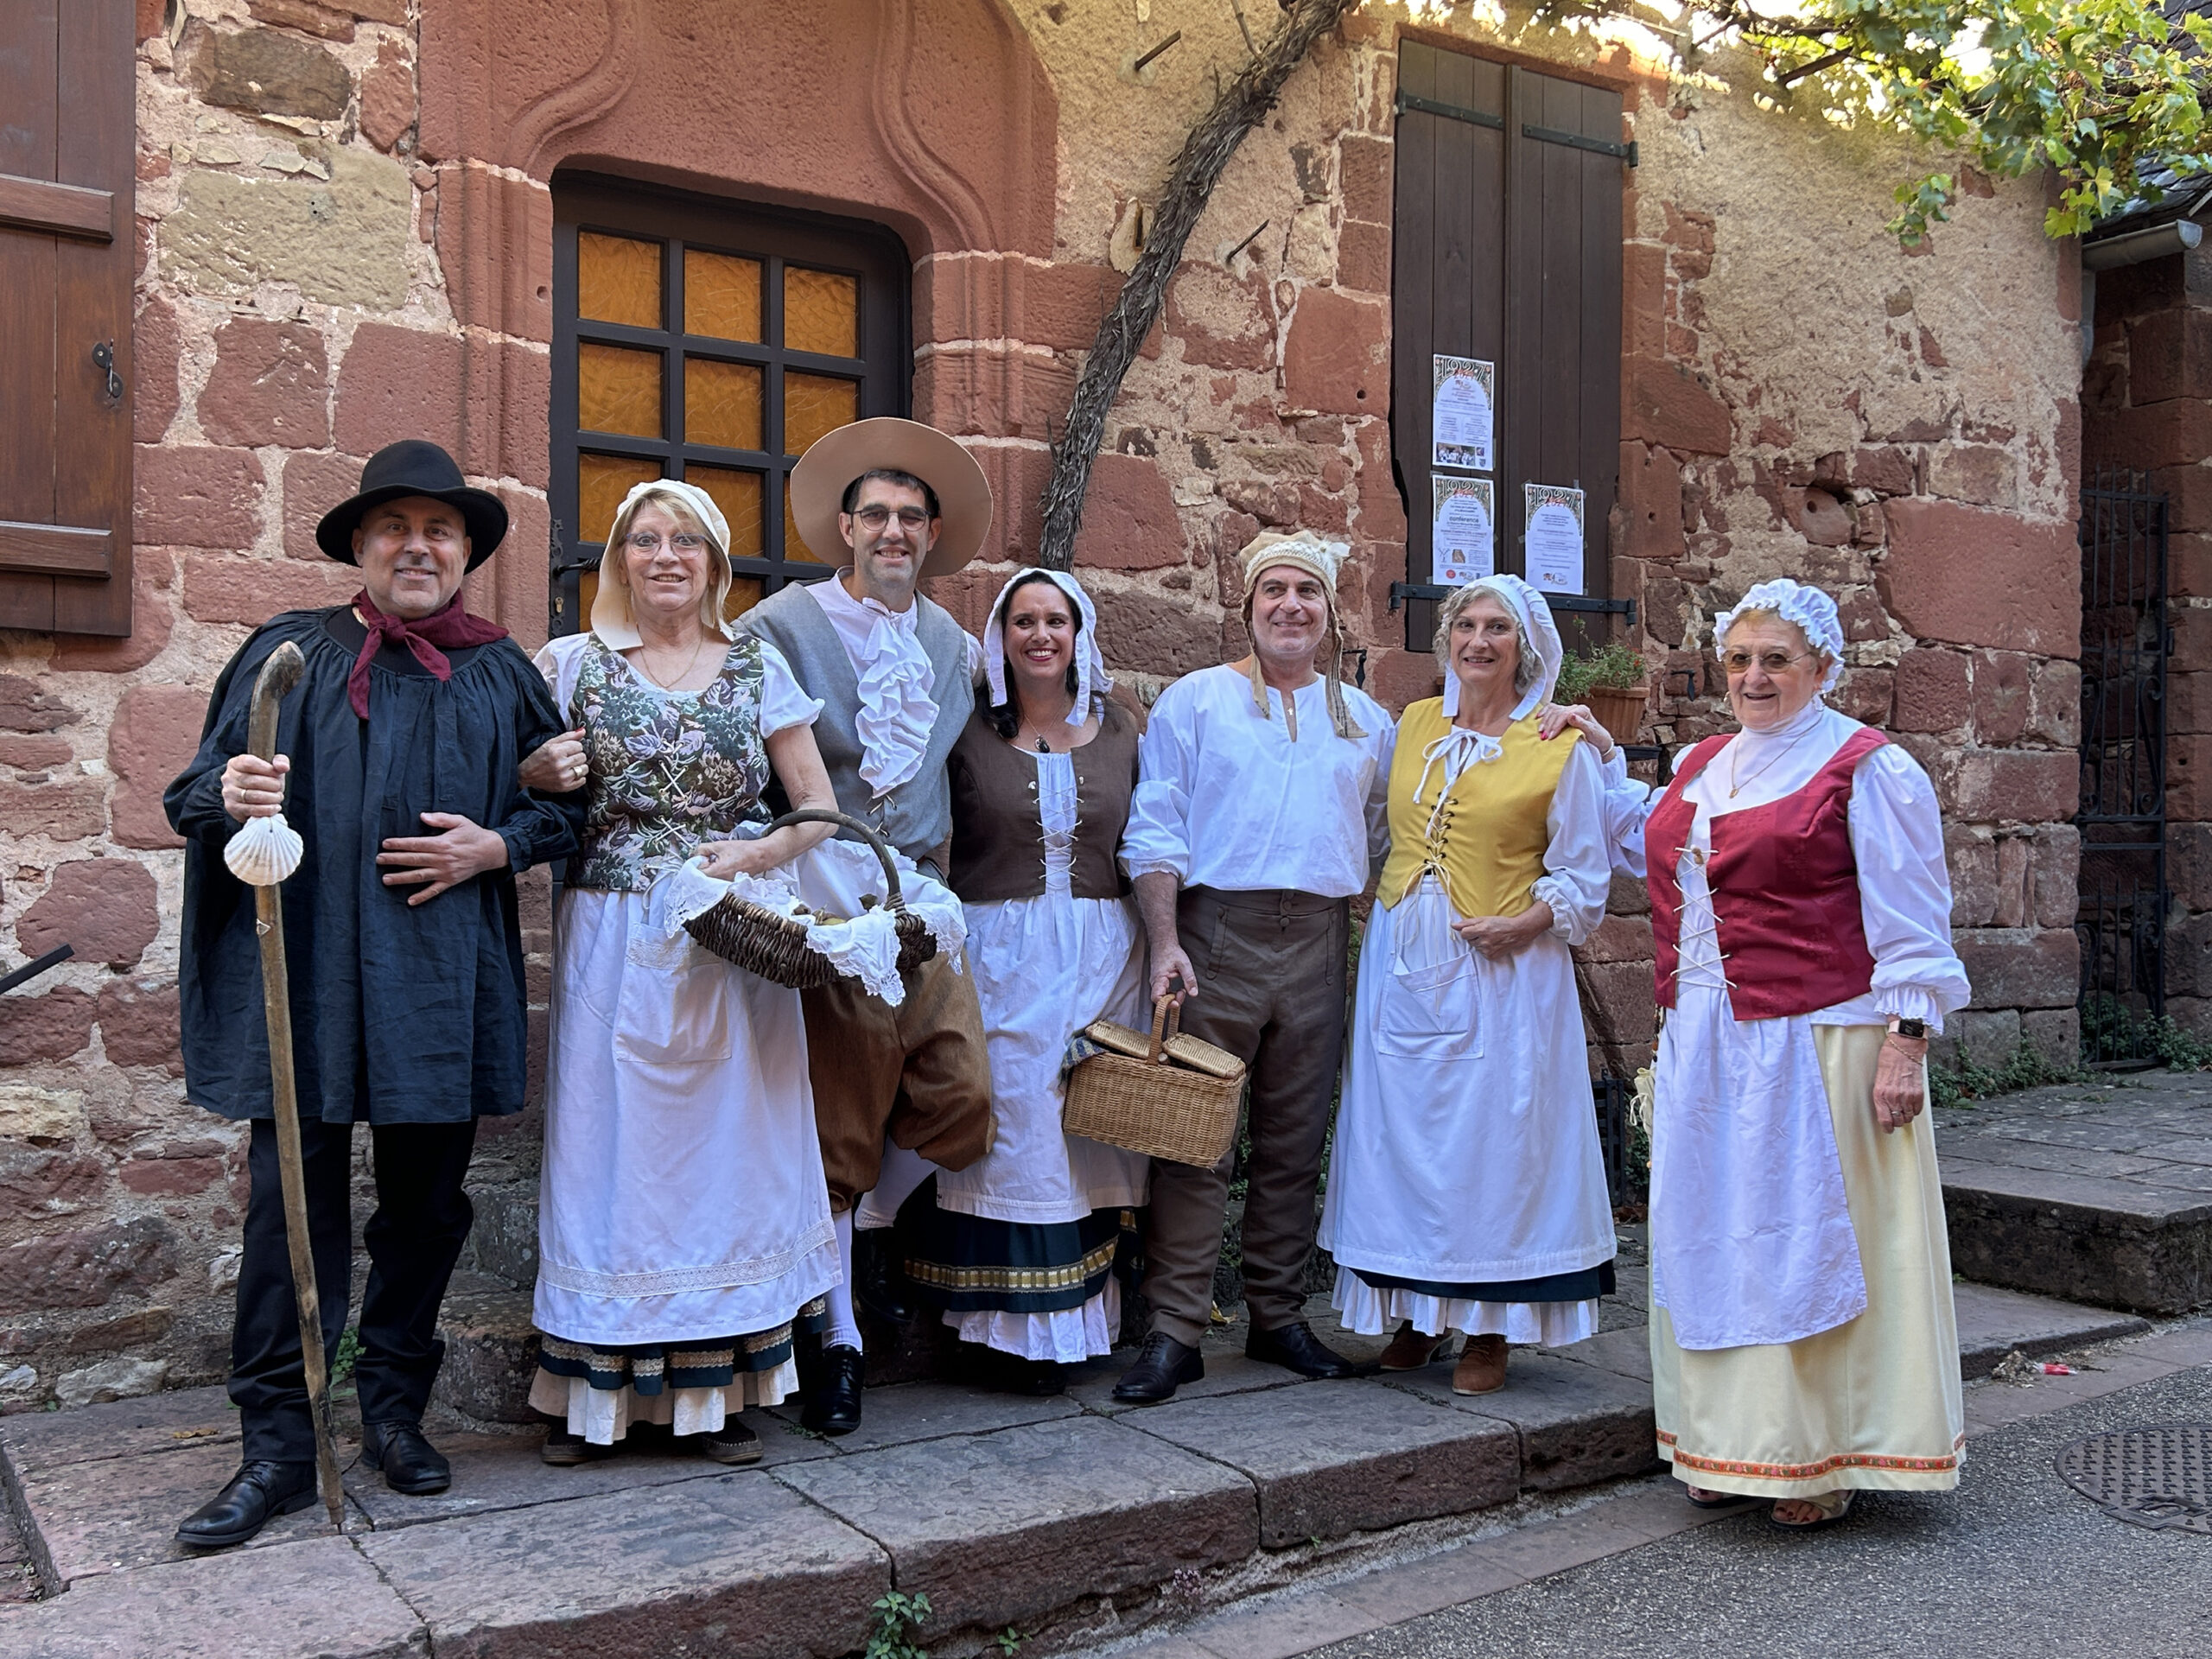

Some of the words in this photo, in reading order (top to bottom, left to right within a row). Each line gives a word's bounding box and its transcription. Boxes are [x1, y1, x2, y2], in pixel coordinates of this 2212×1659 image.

[1440, 357, 1486, 383] 1927
[1441, 479, 1484, 499] 1927
[1533, 487, 1576, 509] 1927
